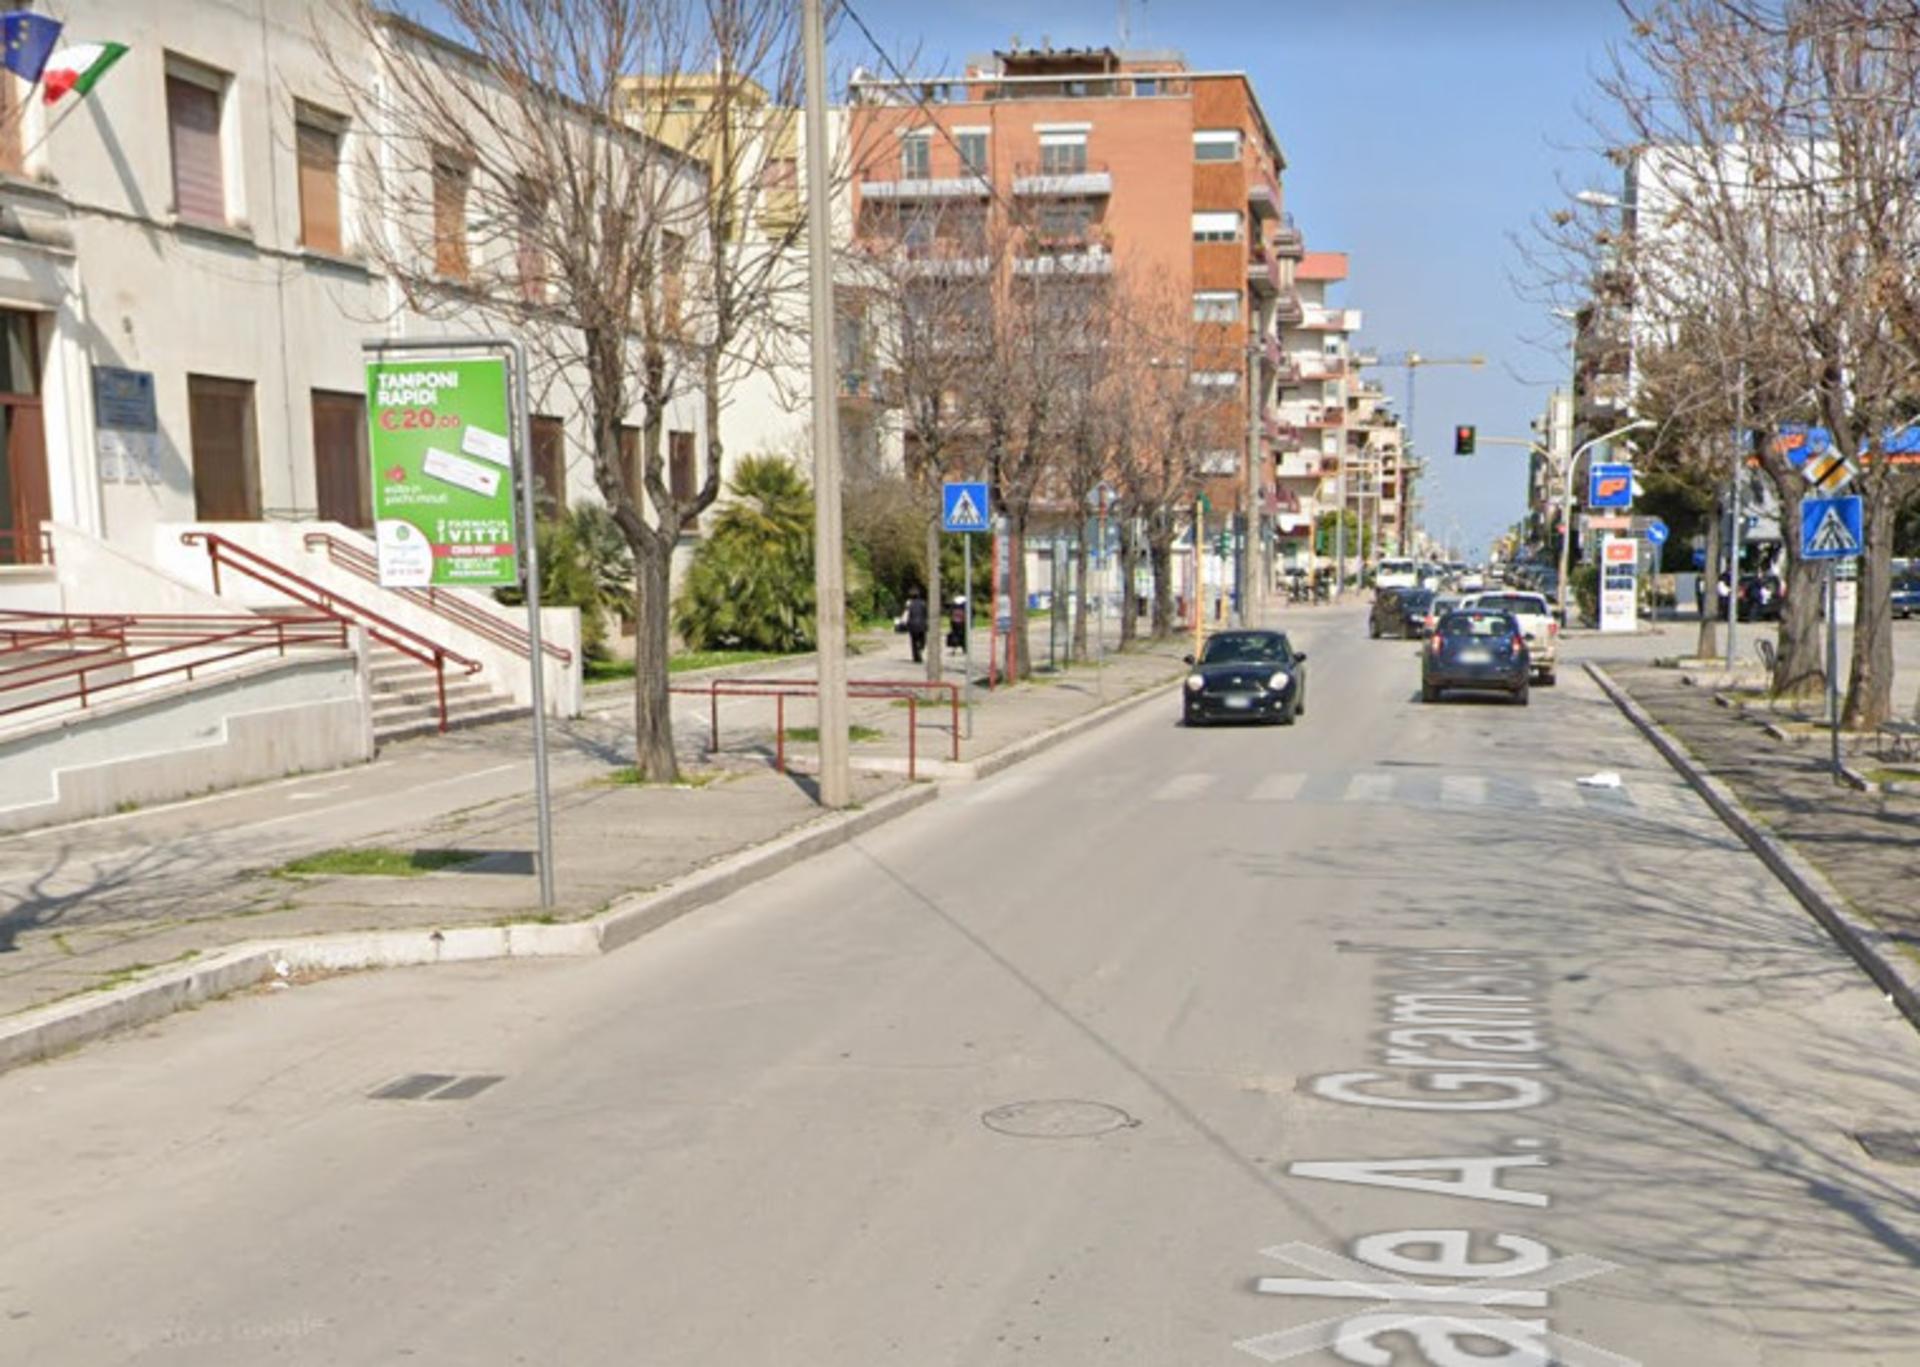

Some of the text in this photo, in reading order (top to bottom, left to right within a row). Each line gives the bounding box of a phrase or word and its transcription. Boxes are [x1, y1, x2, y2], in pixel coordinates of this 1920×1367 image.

[378, 372, 459, 390] TAMPONI
[378, 390, 438, 406] RAPIDI
[449, 528, 510, 543] VITTI
